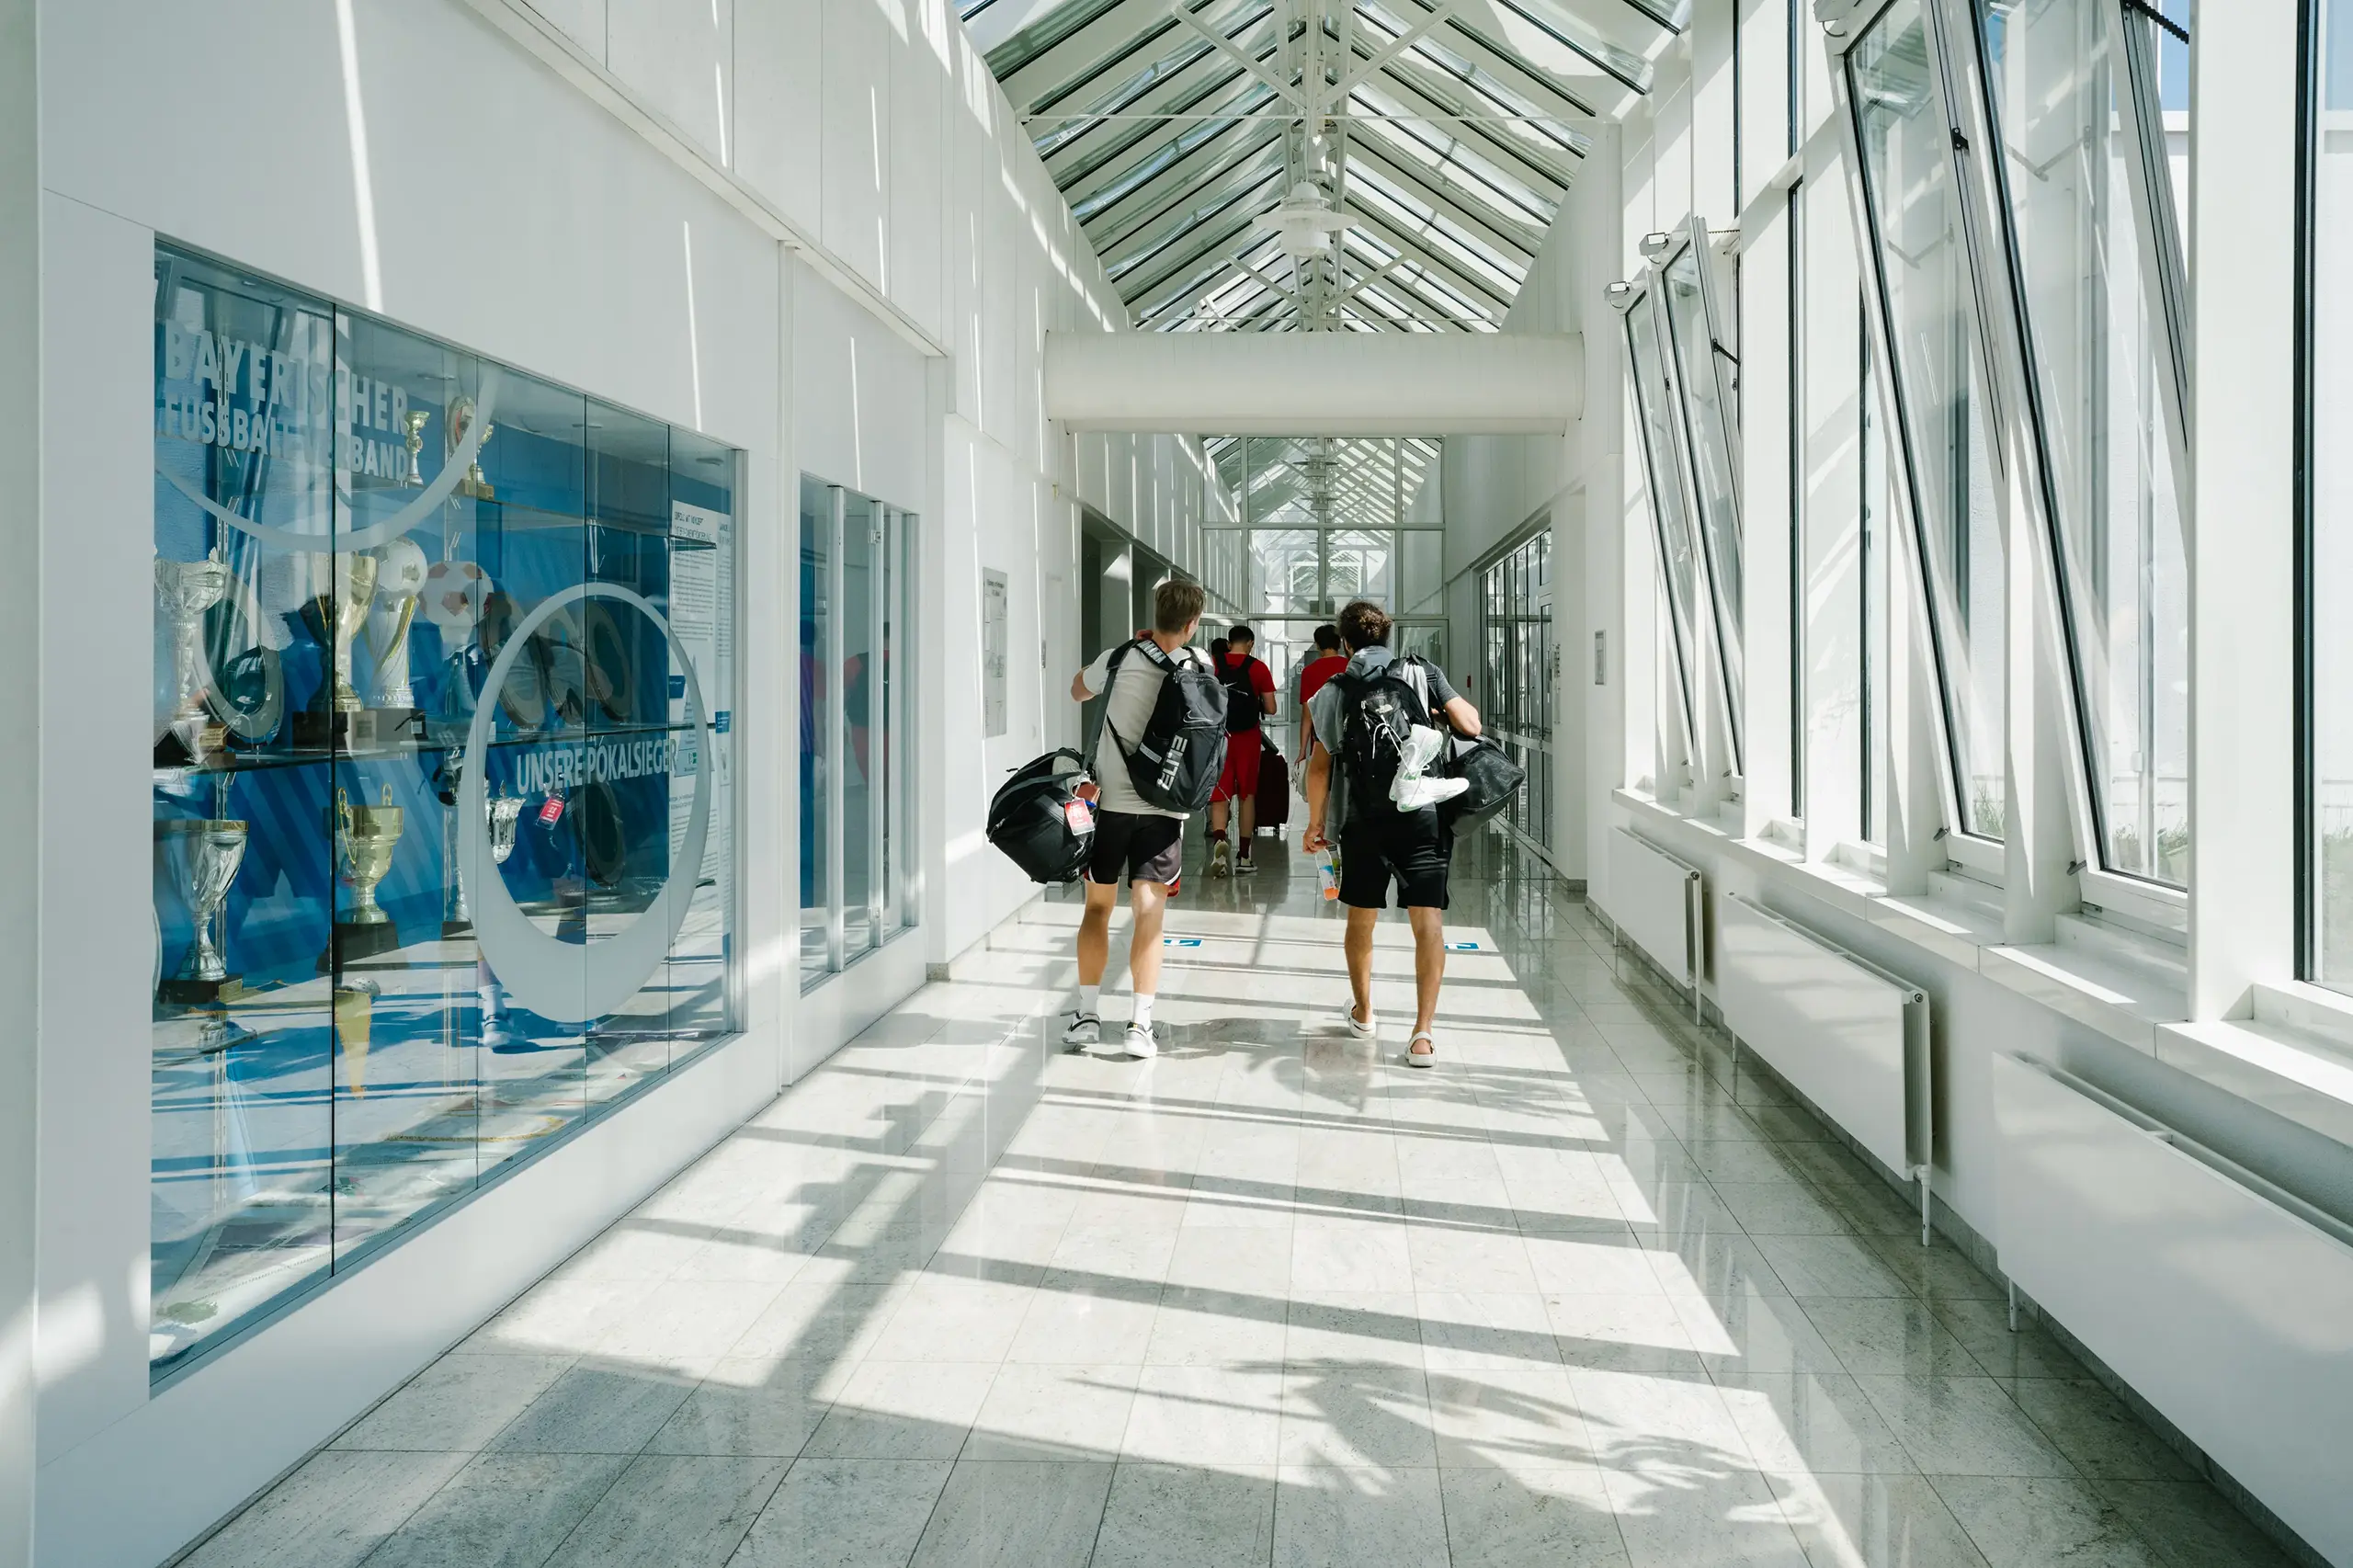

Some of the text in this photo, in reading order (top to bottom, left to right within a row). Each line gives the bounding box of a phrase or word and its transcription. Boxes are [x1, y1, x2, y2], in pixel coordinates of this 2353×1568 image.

[165, 317, 410, 436] BAYERISCHER
[517, 748, 583, 795] UNSERE
[587, 738, 678, 783] POKALSIEGER
[1157, 734, 1188, 790] ELITE
